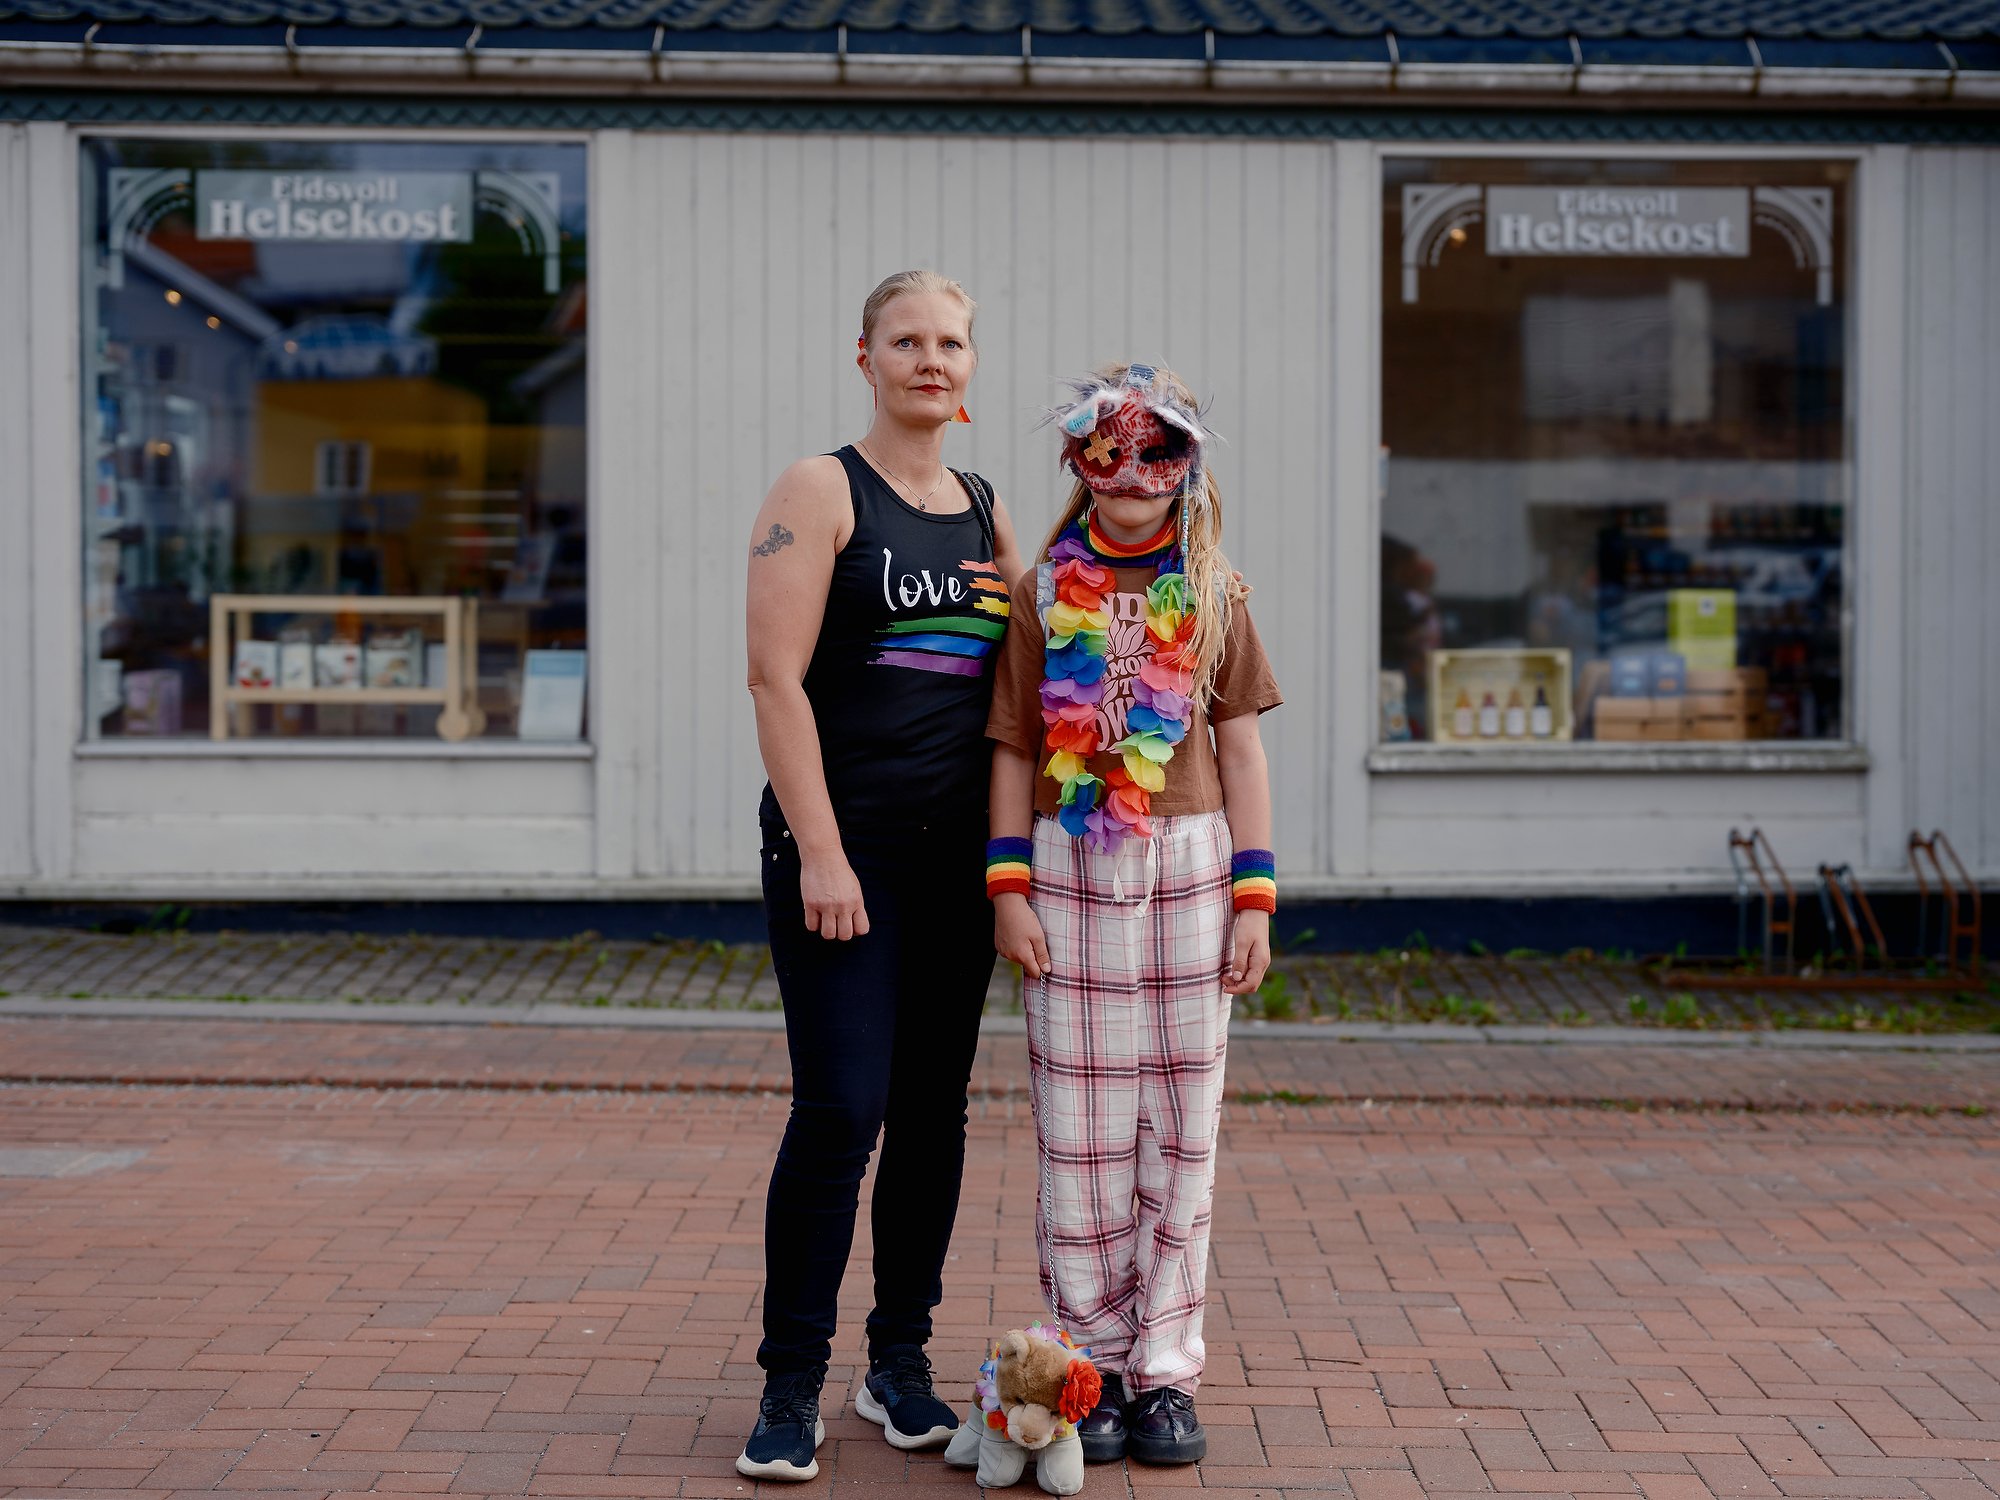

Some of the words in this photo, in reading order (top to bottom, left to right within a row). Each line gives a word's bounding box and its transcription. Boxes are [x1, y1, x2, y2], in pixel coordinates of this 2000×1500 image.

[271, 175, 398, 202] Eidsvoll
[1558, 190, 1678, 216] Eidsvoll
[209, 200, 460, 239] Helsekost
[1500, 213, 1732, 251] Helsekost
